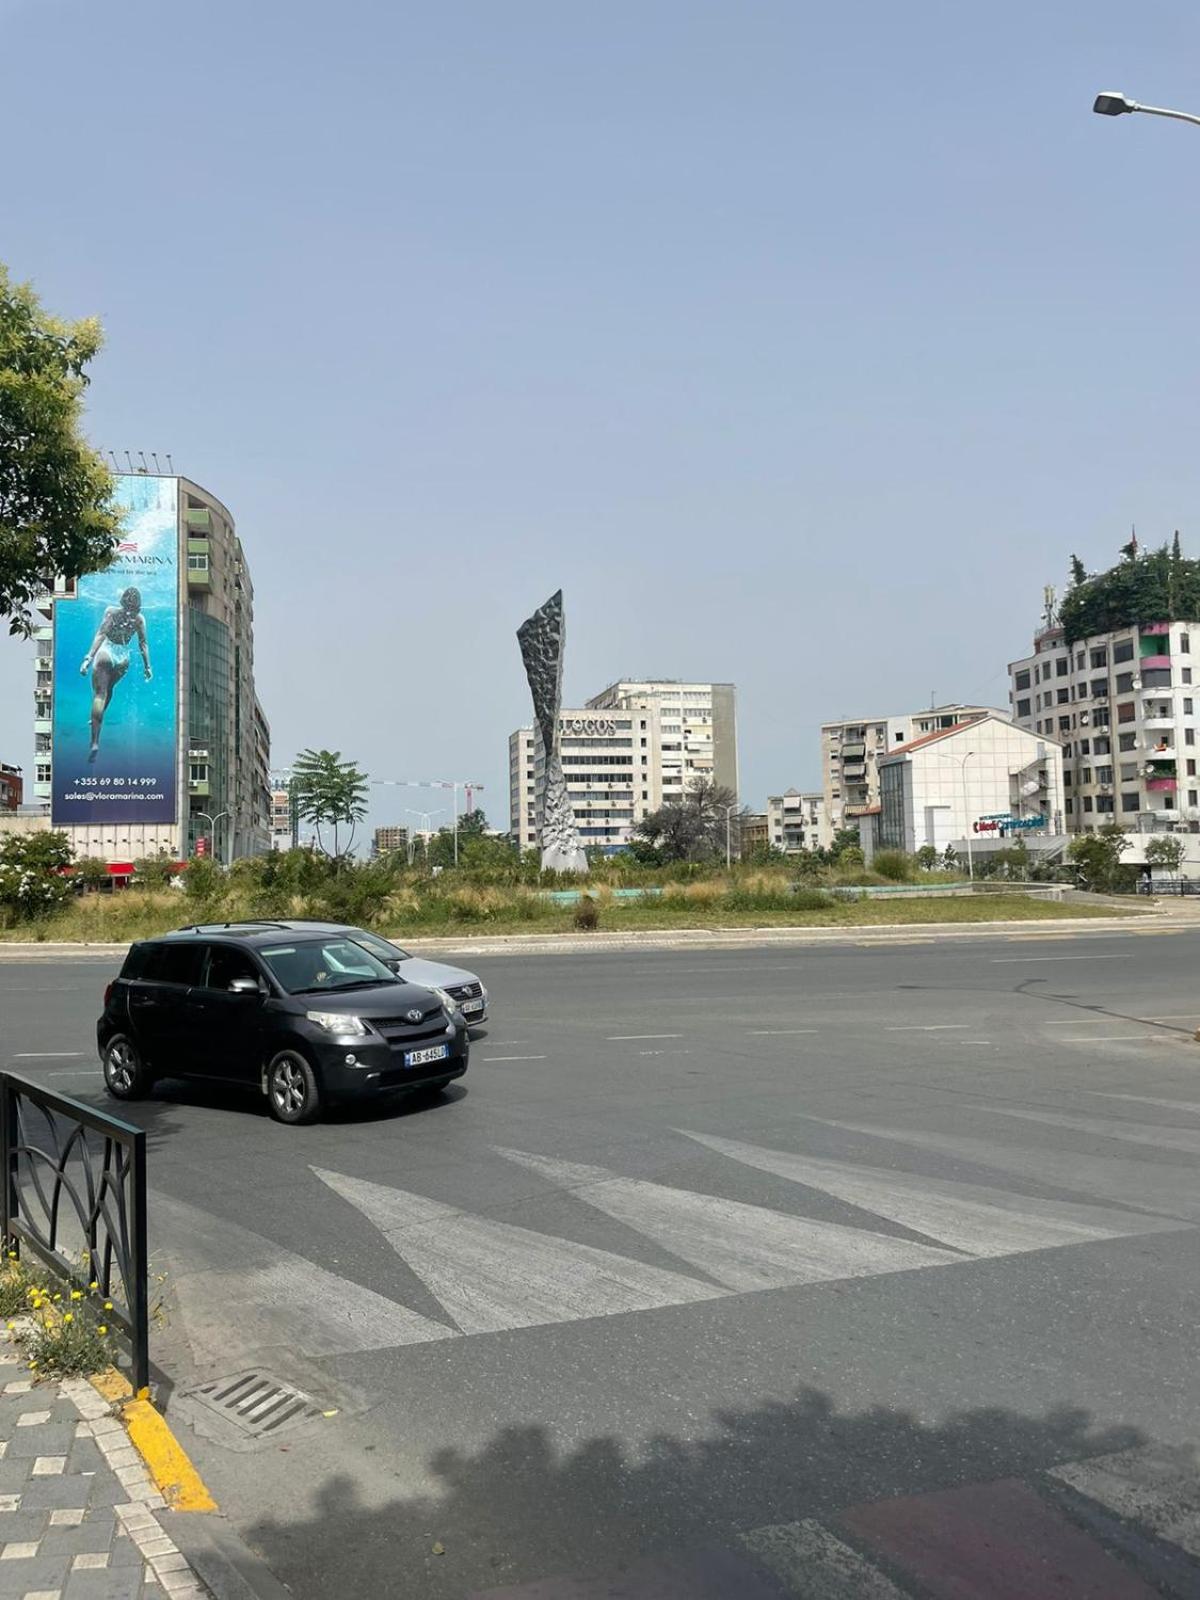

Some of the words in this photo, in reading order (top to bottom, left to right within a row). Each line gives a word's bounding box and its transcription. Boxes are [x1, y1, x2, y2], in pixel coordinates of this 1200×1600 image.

[561, 718, 616, 735] LOGOS
[74, 777, 97, 786] +355
[100, 777, 111, 786] 69
[113, 777, 125, 786] 80
[128, 777, 138, 786] 14
[140, 777, 157, 786] 999
[64, 791, 164, 801] sales@vloramarina.com
